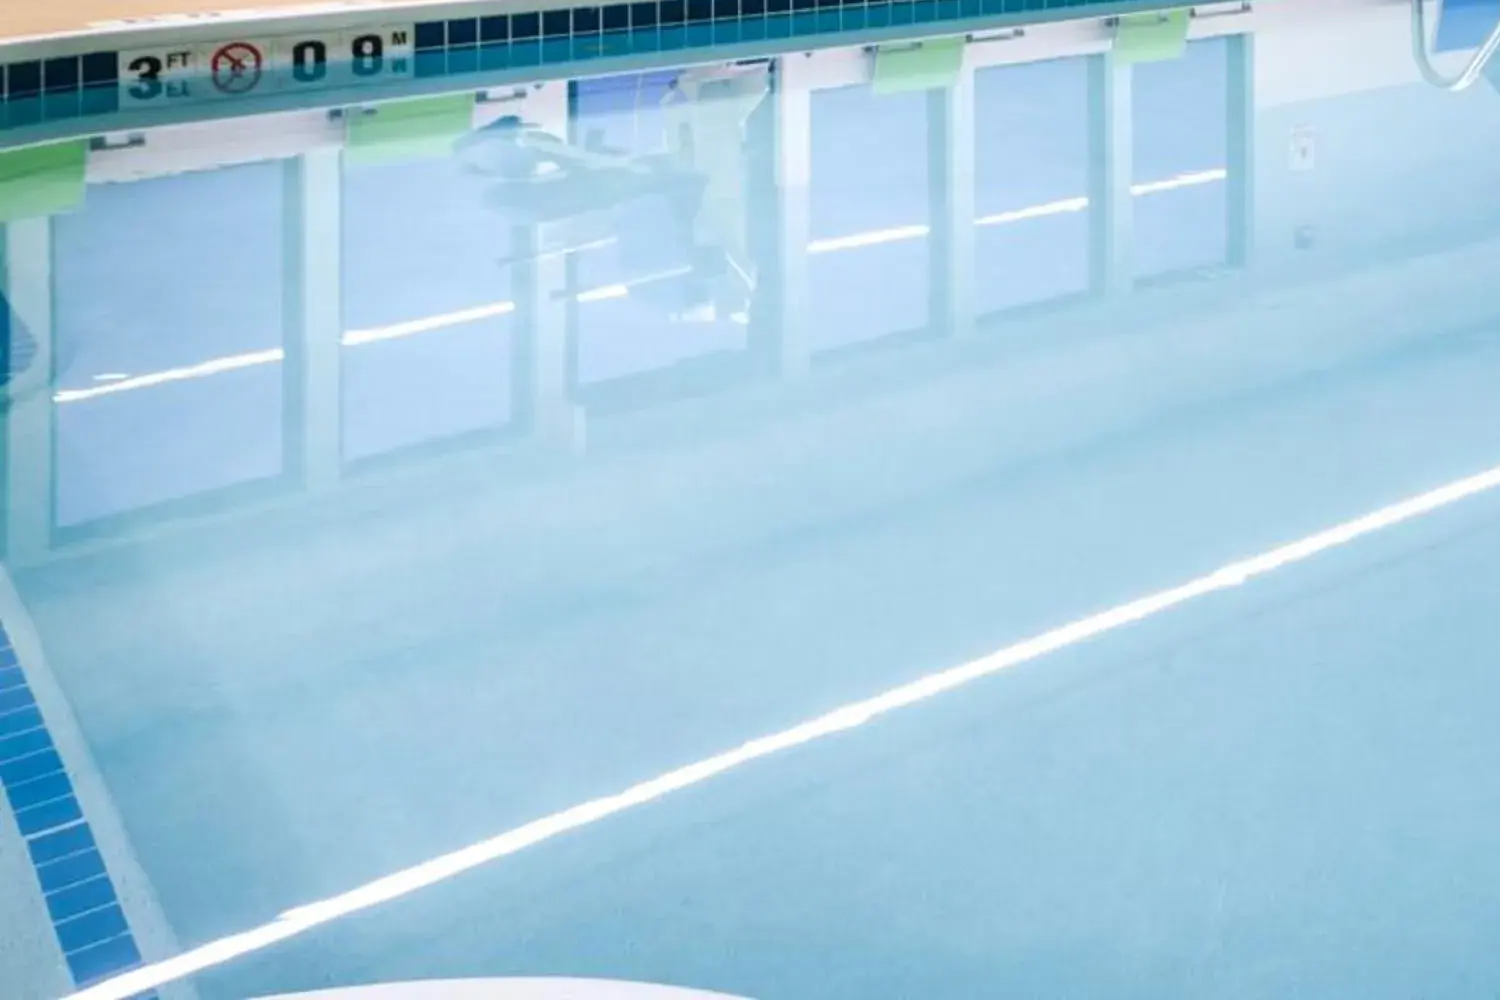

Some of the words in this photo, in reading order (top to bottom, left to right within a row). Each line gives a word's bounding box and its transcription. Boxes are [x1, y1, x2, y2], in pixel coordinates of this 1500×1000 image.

[127, 55, 162, 94] 3
[166, 51, 192, 69] FT
[391, 30, 407, 46] M
